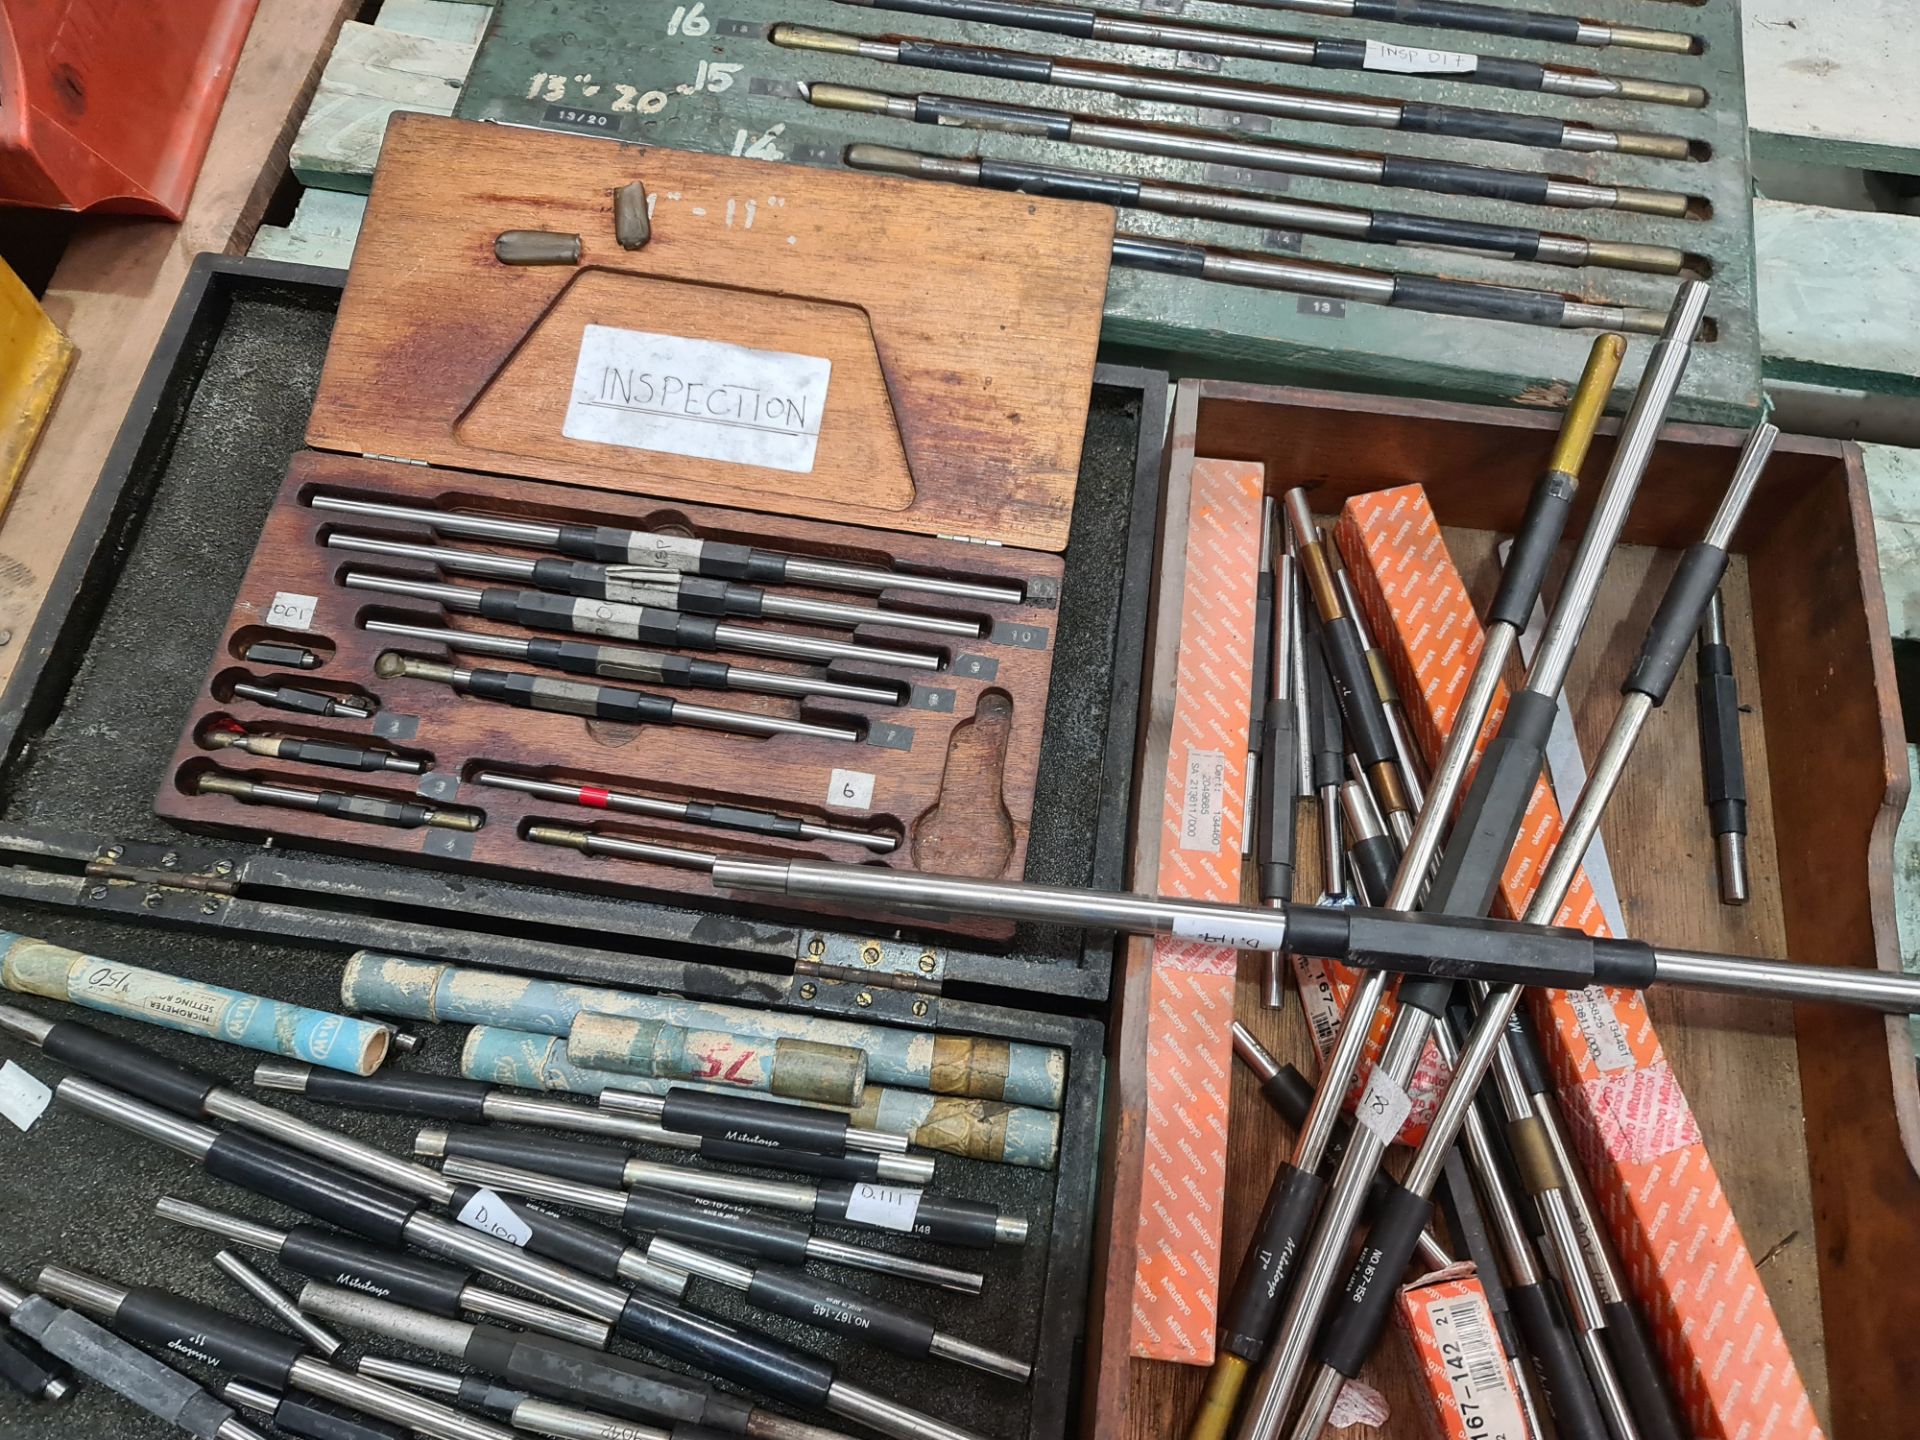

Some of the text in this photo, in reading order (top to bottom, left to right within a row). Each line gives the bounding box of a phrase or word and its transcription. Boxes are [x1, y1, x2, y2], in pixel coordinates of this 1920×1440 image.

[667, 2, 710, 36] 16
[694, 59, 744, 93] 15
[1313, 301, 1331, 313] 13
[600, 366, 807, 429] INSPECTION
[1012, 630, 1031, 642] 10
[842, 782, 855, 799] 6
[149, 1000, 211, 1024] MICROMETER
[175, 997, 215, 1015] SETTING
[724, 1130, 780, 1148] Mitutoyo
[1267, 1236, 1296, 1299] Mitutoyo
[336, 1272, 391, 1297] Mitutoyo
[167, 1338, 221, 1367] Mitutoyo
[1442, 1341, 1489, 1440] 167-142
